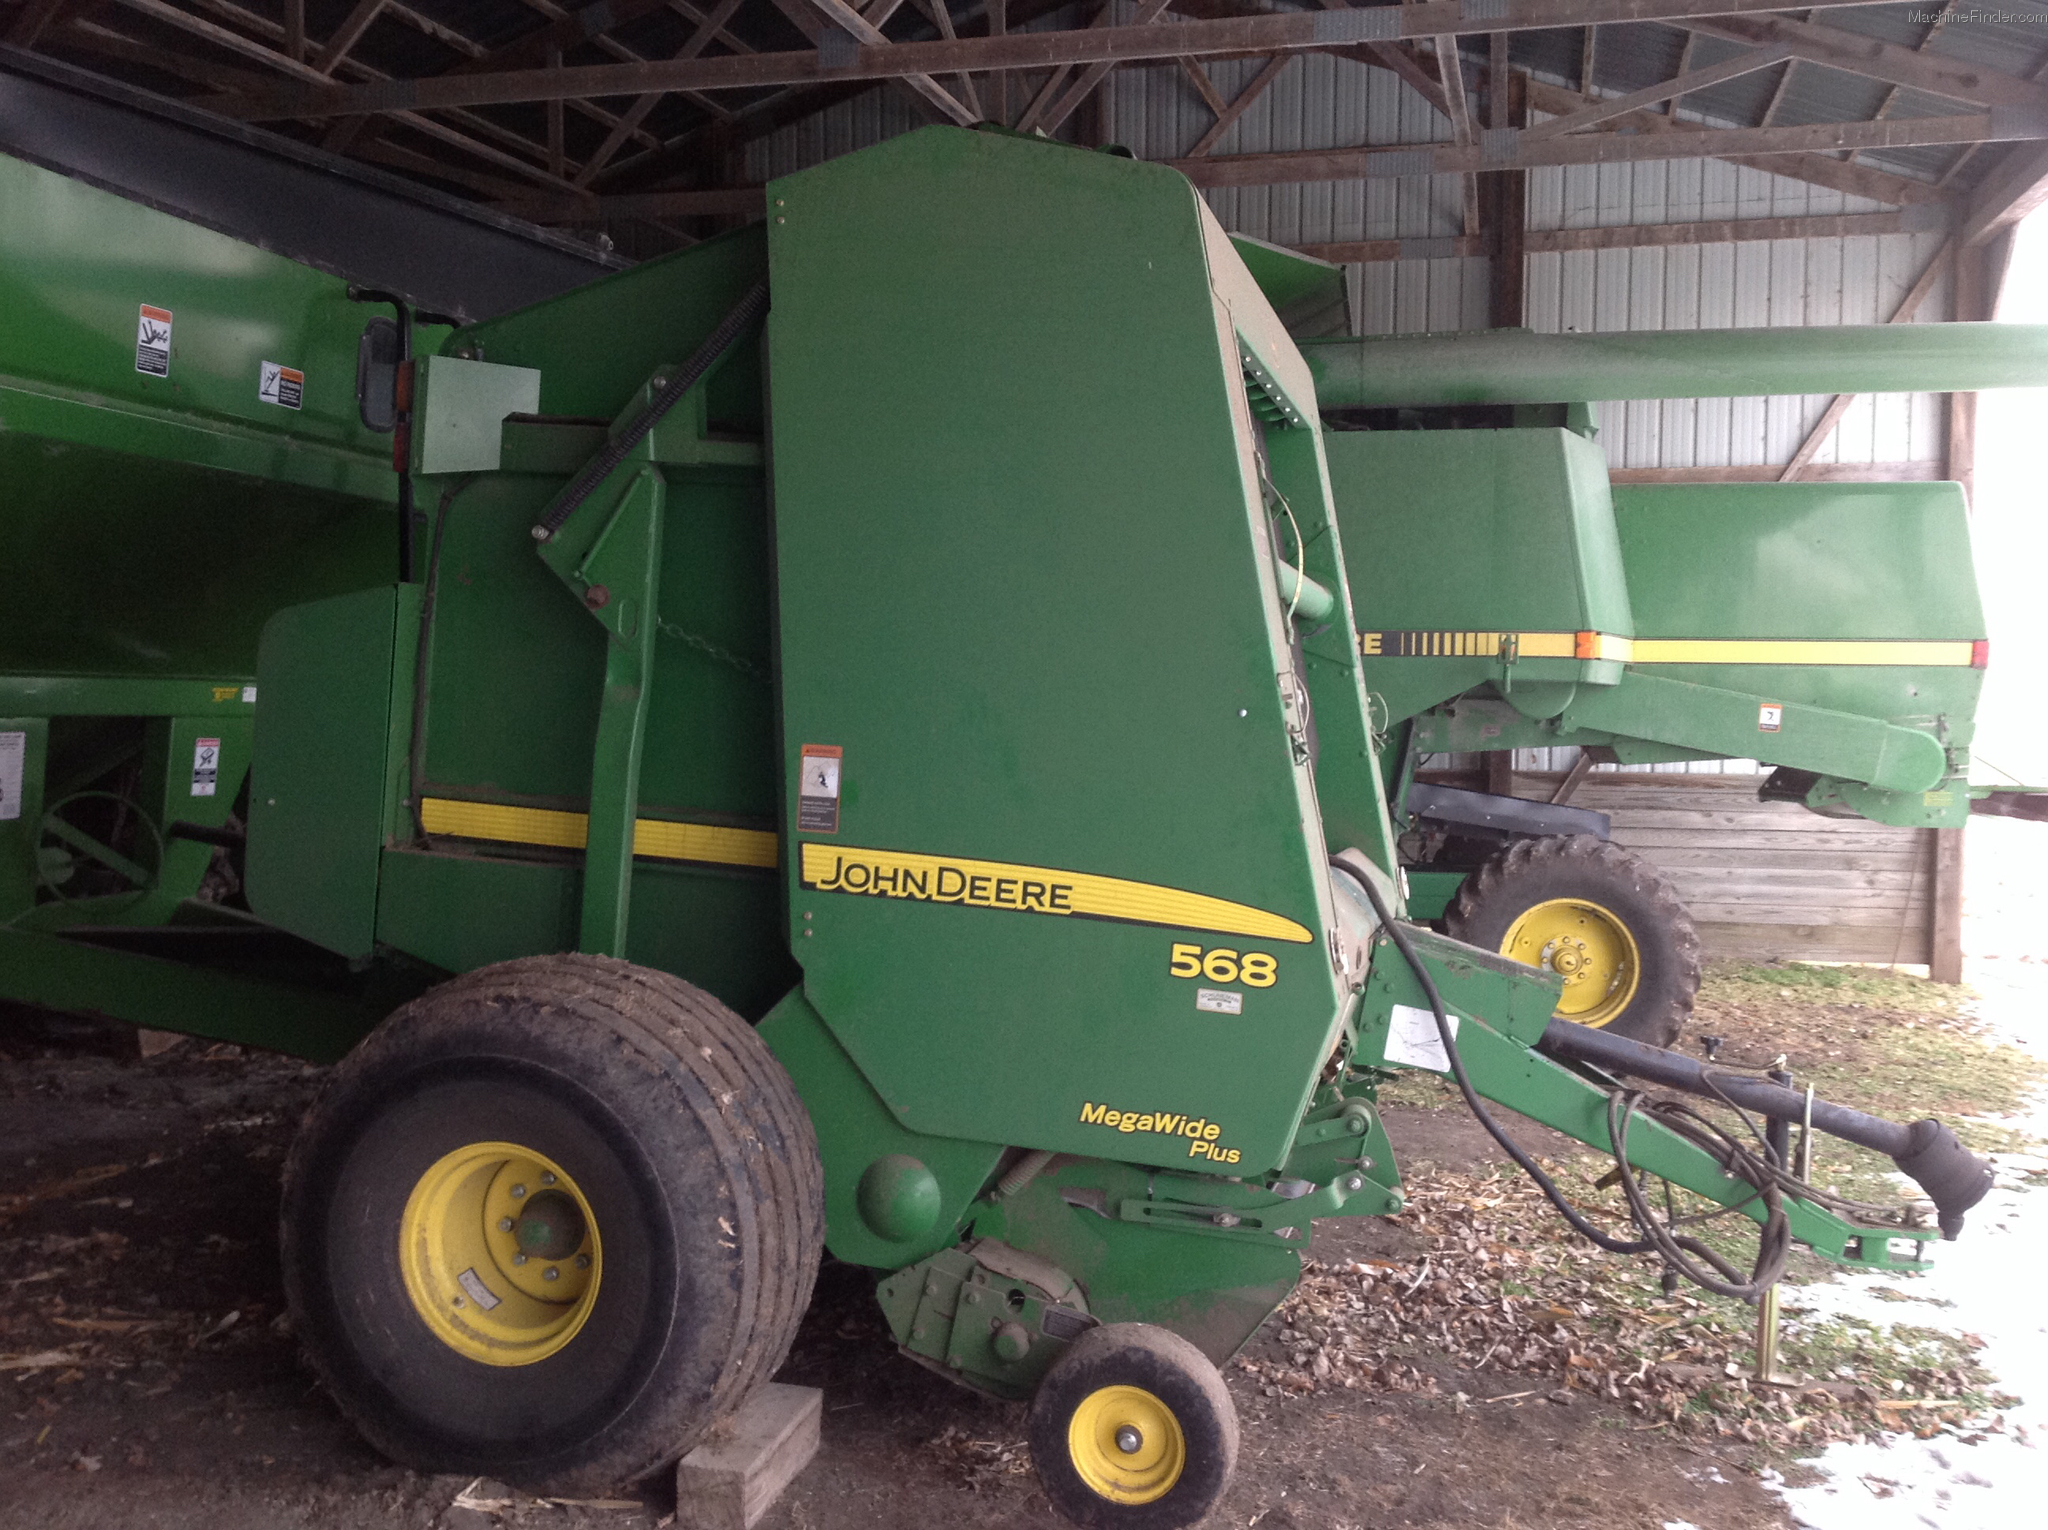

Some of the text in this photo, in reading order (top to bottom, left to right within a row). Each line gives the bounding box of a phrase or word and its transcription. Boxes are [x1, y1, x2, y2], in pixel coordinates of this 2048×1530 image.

[1356, 632, 1383, 655] E
[821, 856, 1073, 910] JOHN DEERE
[1169, 942, 1278, 988] 568
[1079, 1102, 1221, 1141] MegaWide
[1188, 1140, 1242, 1164] Plus
